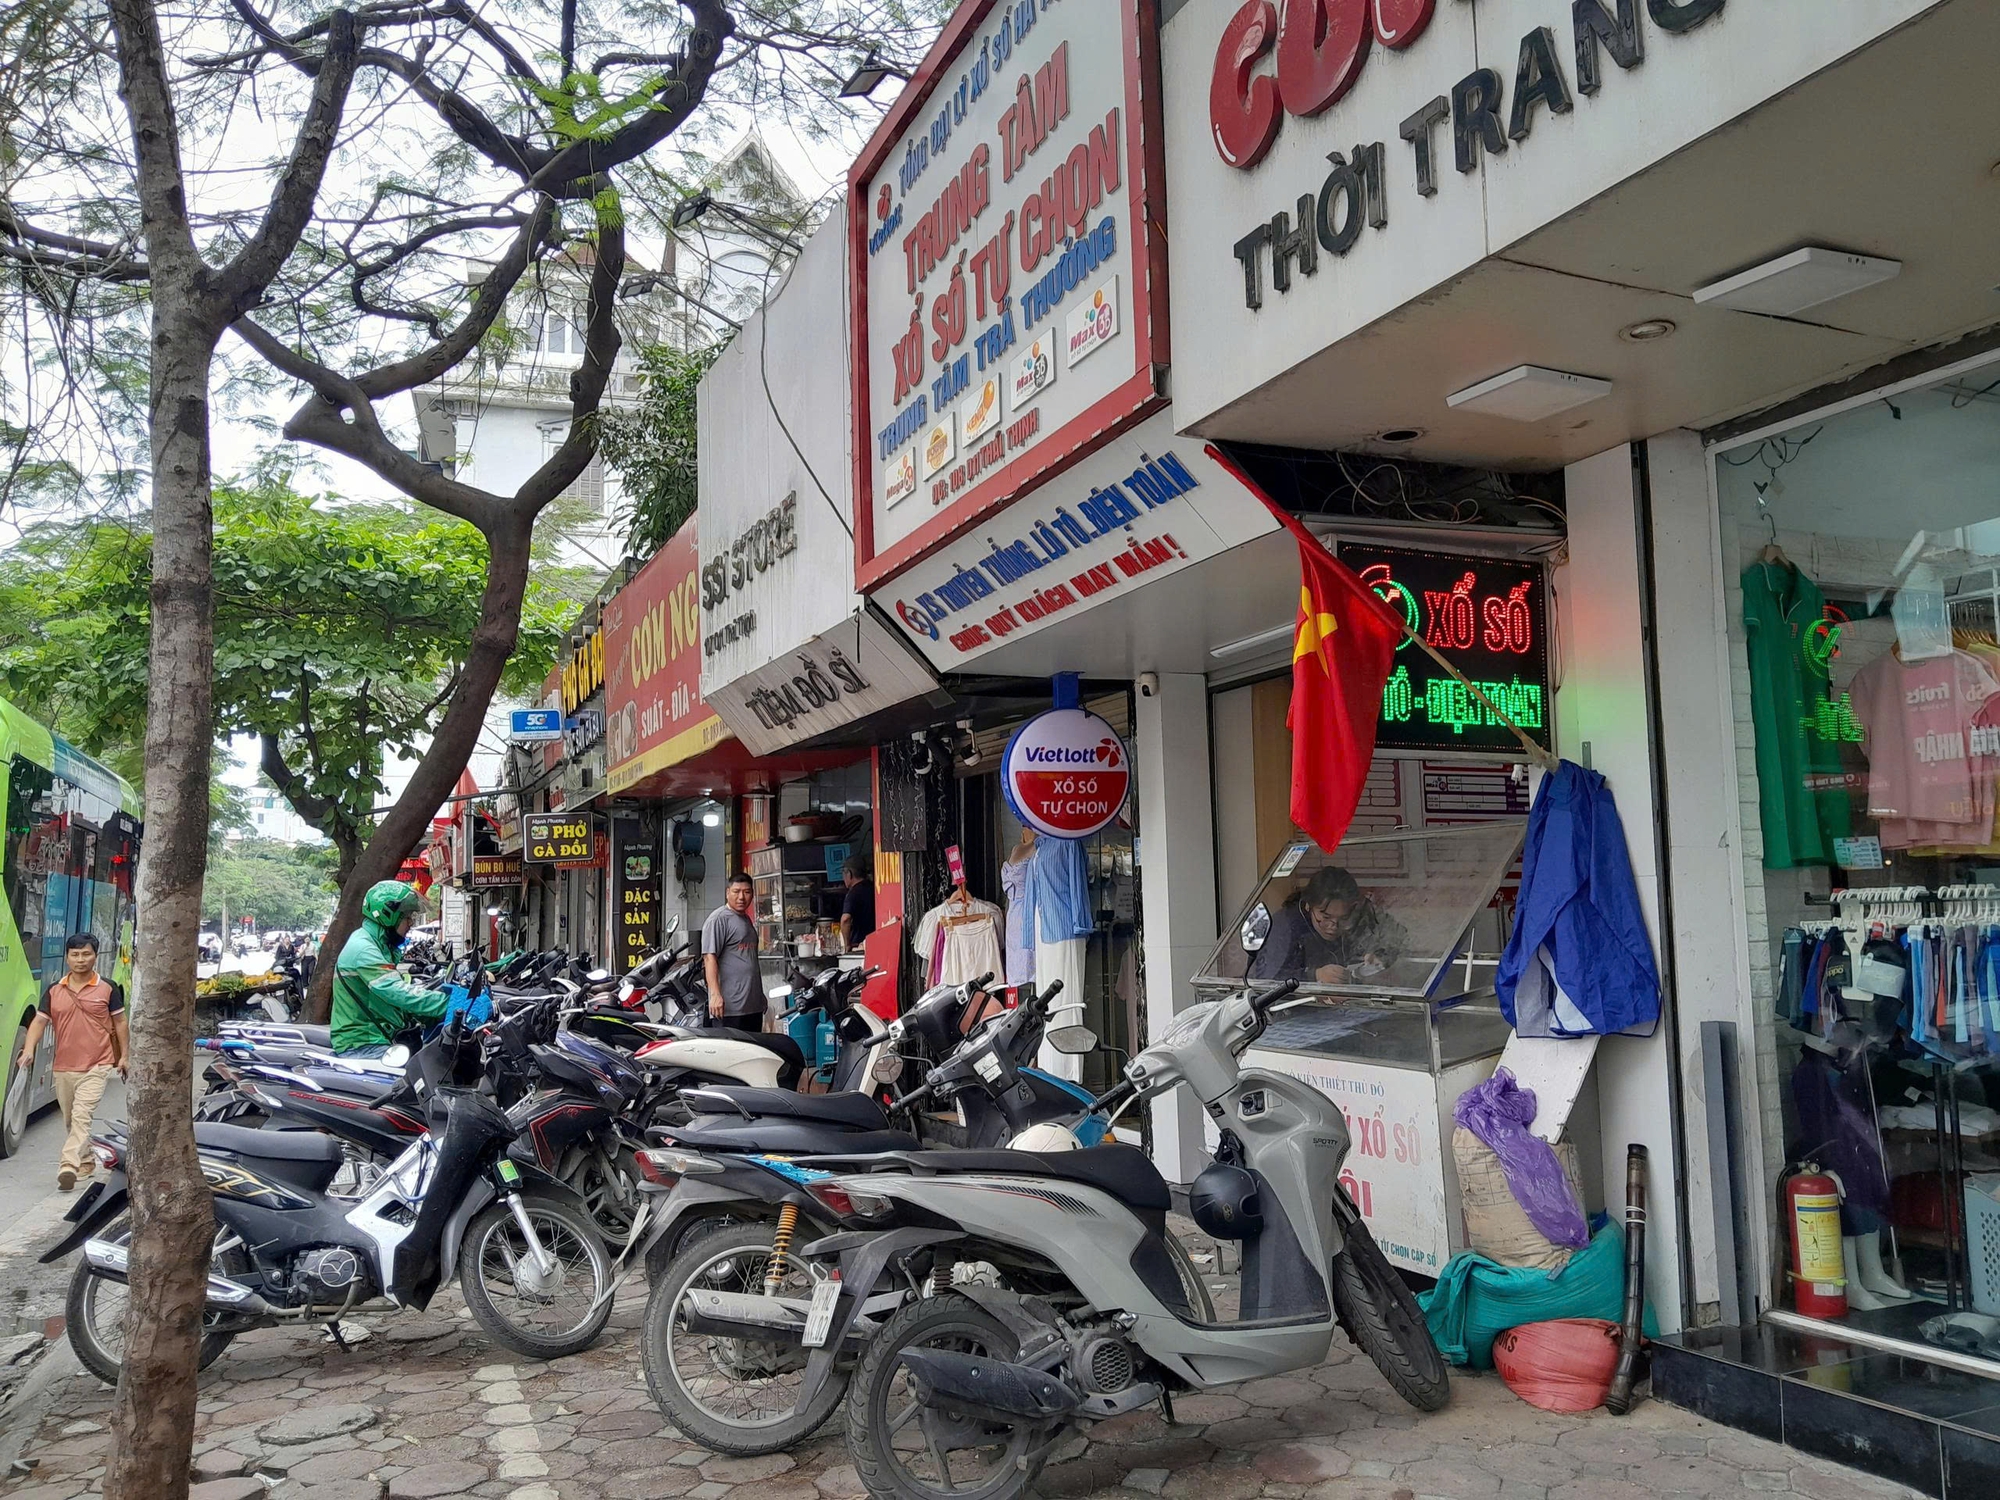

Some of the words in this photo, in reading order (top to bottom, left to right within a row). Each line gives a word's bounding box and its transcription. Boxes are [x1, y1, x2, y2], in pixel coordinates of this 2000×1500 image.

[899, 138, 929, 197] TỔNG
[992, 5, 1012, 72] SỐ
[902, 143, 990, 294] TRUNG
[998, 40, 1070, 184] TÂM
[1234, 141, 1388, 311] THỜI
[892, 292, 925, 406] XỔ
[931, 248, 968, 362] SỐ
[970, 209, 1013, 322] TỰ
[1019, 107, 1121, 274] CHỌN
[878, 394, 927, 461] TRUNG
[931, 352, 970, 413] TÂM
[974, 296, 1017, 372] TRẢ
[1020, 215, 1117, 330] THƯỞNG
[1070, 323, 1095, 353] Max
[731, 490, 798, 590] STORE
[934, 562, 997, 613] TRUYỀN
[1122, 450, 1201, 512] TOÁN
[949, 624, 991, 652] CHÚC
[984, 604, 1021, 637] QUÝ
[1013, 589, 1079, 623] KHÁCH
[1069, 561, 1119, 598] MAY
[1424, 571, 1477, 649] XỔ
[1483, 581, 1532, 654] SỐ
[632, 594, 667, 690] CƠM
[669, 569, 699, 661] NG
[745, 687, 810, 730] TIỆM
[792, 652, 839, 708] ĐỒ
[641, 692, 664, 739] SUẤT
[1025, 746, 1096, 763] Vietlott
[1053, 776, 1074, 794] XỔ
[1078, 777, 1098, 794] SỐ
[1041, 799, 1063, 818] TỰ
[1066, 801, 1108, 817] CHỌN
[533, 843, 556, 857] GÀ
[560, 839, 588, 857] ĐỒI
[553, 820, 587, 839] PHỞ
[475, 860, 491, 874] BÚN
[494, 860, 504, 873] BÒ
[506, 859, 521, 873] HUẾ
[475, 876, 487, 884] CƠM
[488, 875, 500, 884] TẤM
[624, 887, 651, 906] ĐẶC
[624, 907, 649, 924] SẢN
[627, 930, 646, 946] GÀ
[1319, 1073, 1347, 1092] THIẾT
[1348, 1077, 1368, 1095] THỦ
[1370, 1081, 1385, 1098] ĐÔ
[1357, 1104, 1386, 1159] XỔ
[1393, 1112, 1421, 1166] SỐ
[1391, 1243, 1410, 1260] CHỌN
